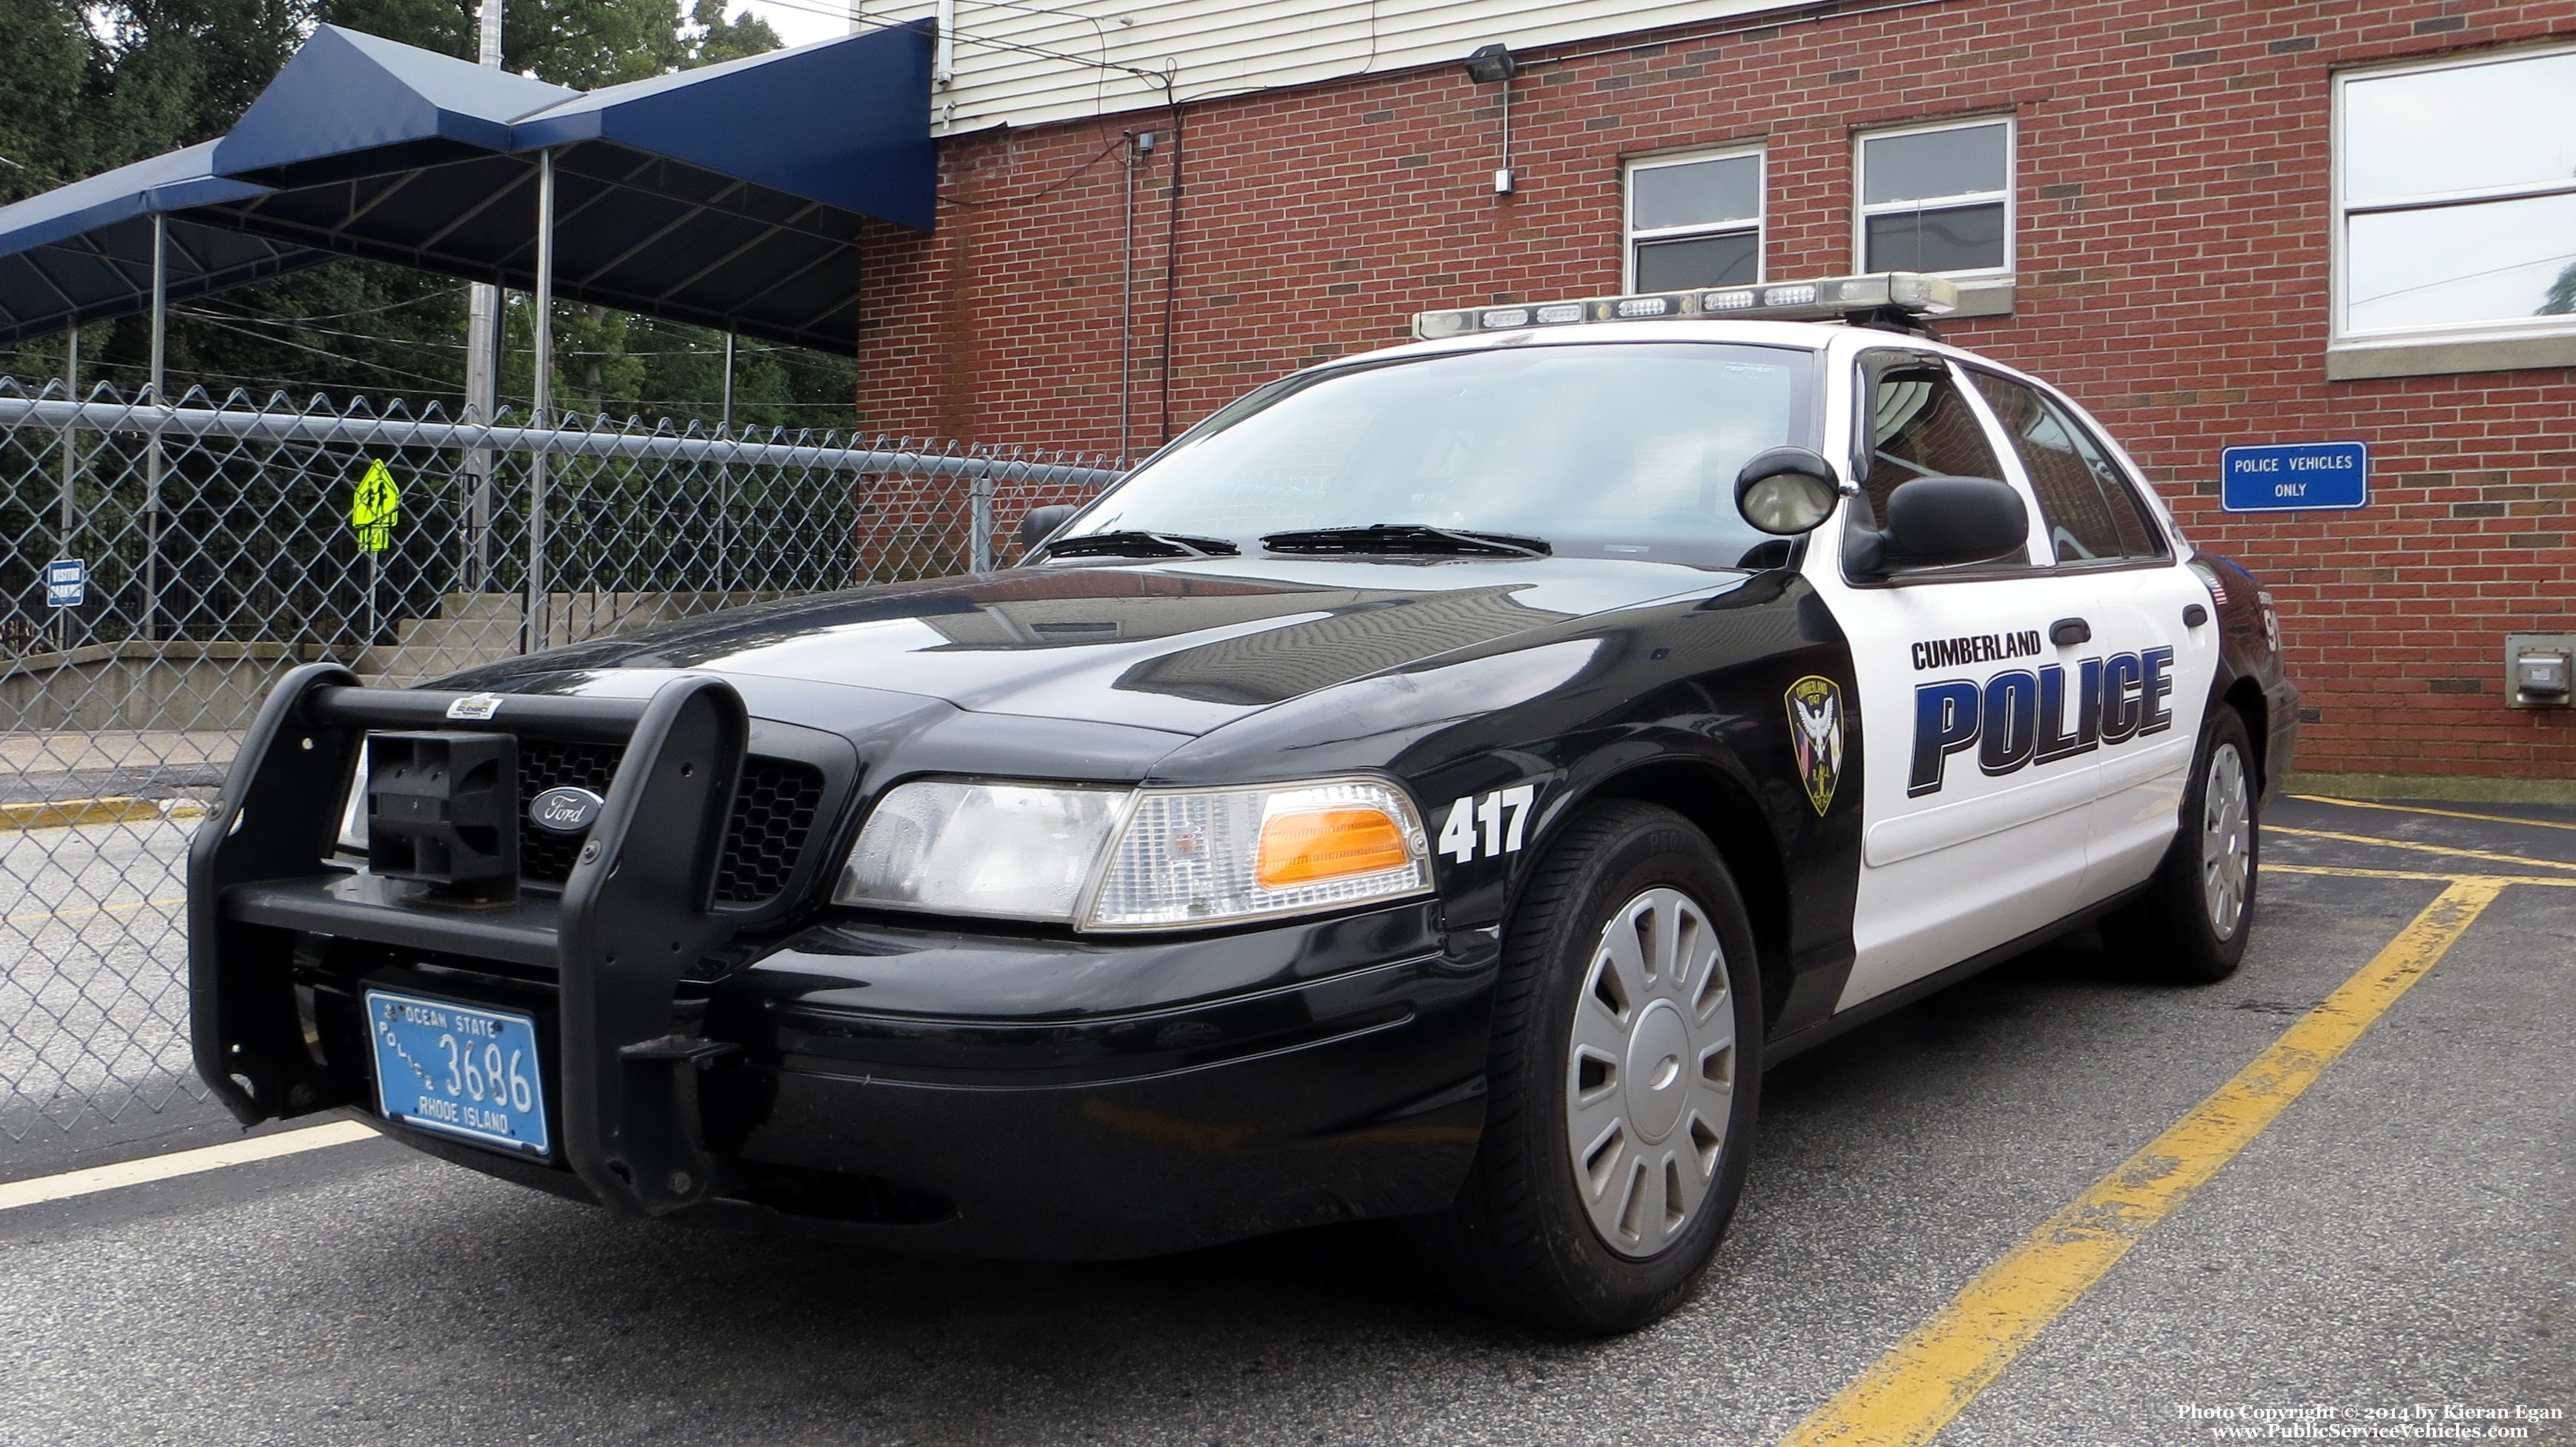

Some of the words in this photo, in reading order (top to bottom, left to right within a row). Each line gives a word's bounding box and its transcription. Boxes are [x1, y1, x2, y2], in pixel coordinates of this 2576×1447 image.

[2234, 458, 2279, 473] POLICE
[2289, 455, 2353, 472] VEHICLES
[2275, 483, 2307, 498] ONLY
[1911, 630, 2041, 670] CUMBERLAND
[1907, 645, 2174, 799] POLICE
[544, 795, 587, 823] Ford
[1438, 784, 1535, 864] 417
[405, 1006, 448, 1029] OCEAN
[456, 1015, 496, 1039] STATE
[379, 1021, 435, 1091] POLICE
[439, 1033, 533, 1113] 3686
[419, 1095, 459, 1124] RHODE
[464, 1106, 509, 1135] ISLAND
